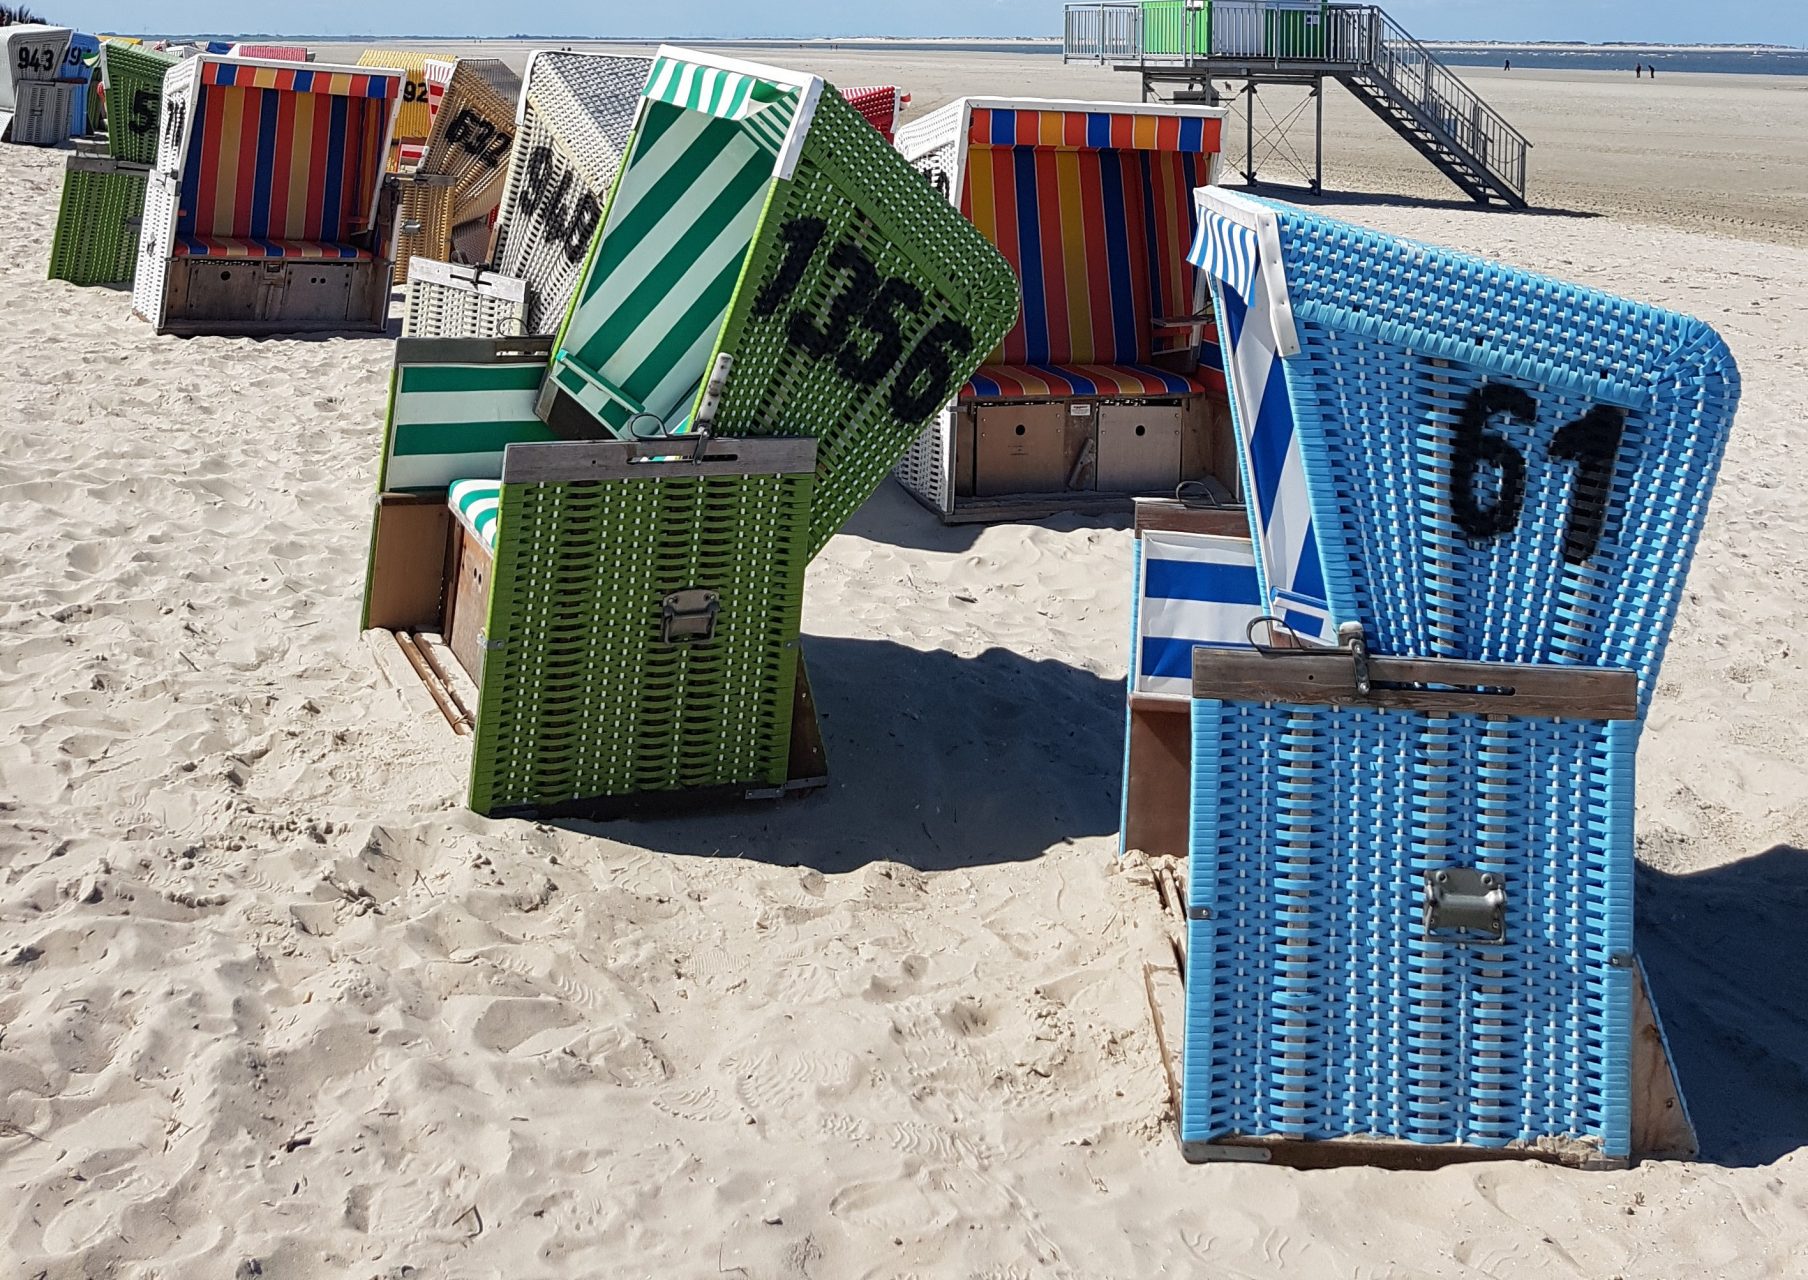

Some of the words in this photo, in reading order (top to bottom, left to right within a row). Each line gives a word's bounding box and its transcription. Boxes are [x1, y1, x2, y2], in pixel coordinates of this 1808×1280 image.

[18, 46, 54, 72] 943
[755, 216, 972, 423] 1356
[1450, 383, 1626, 565] 61
